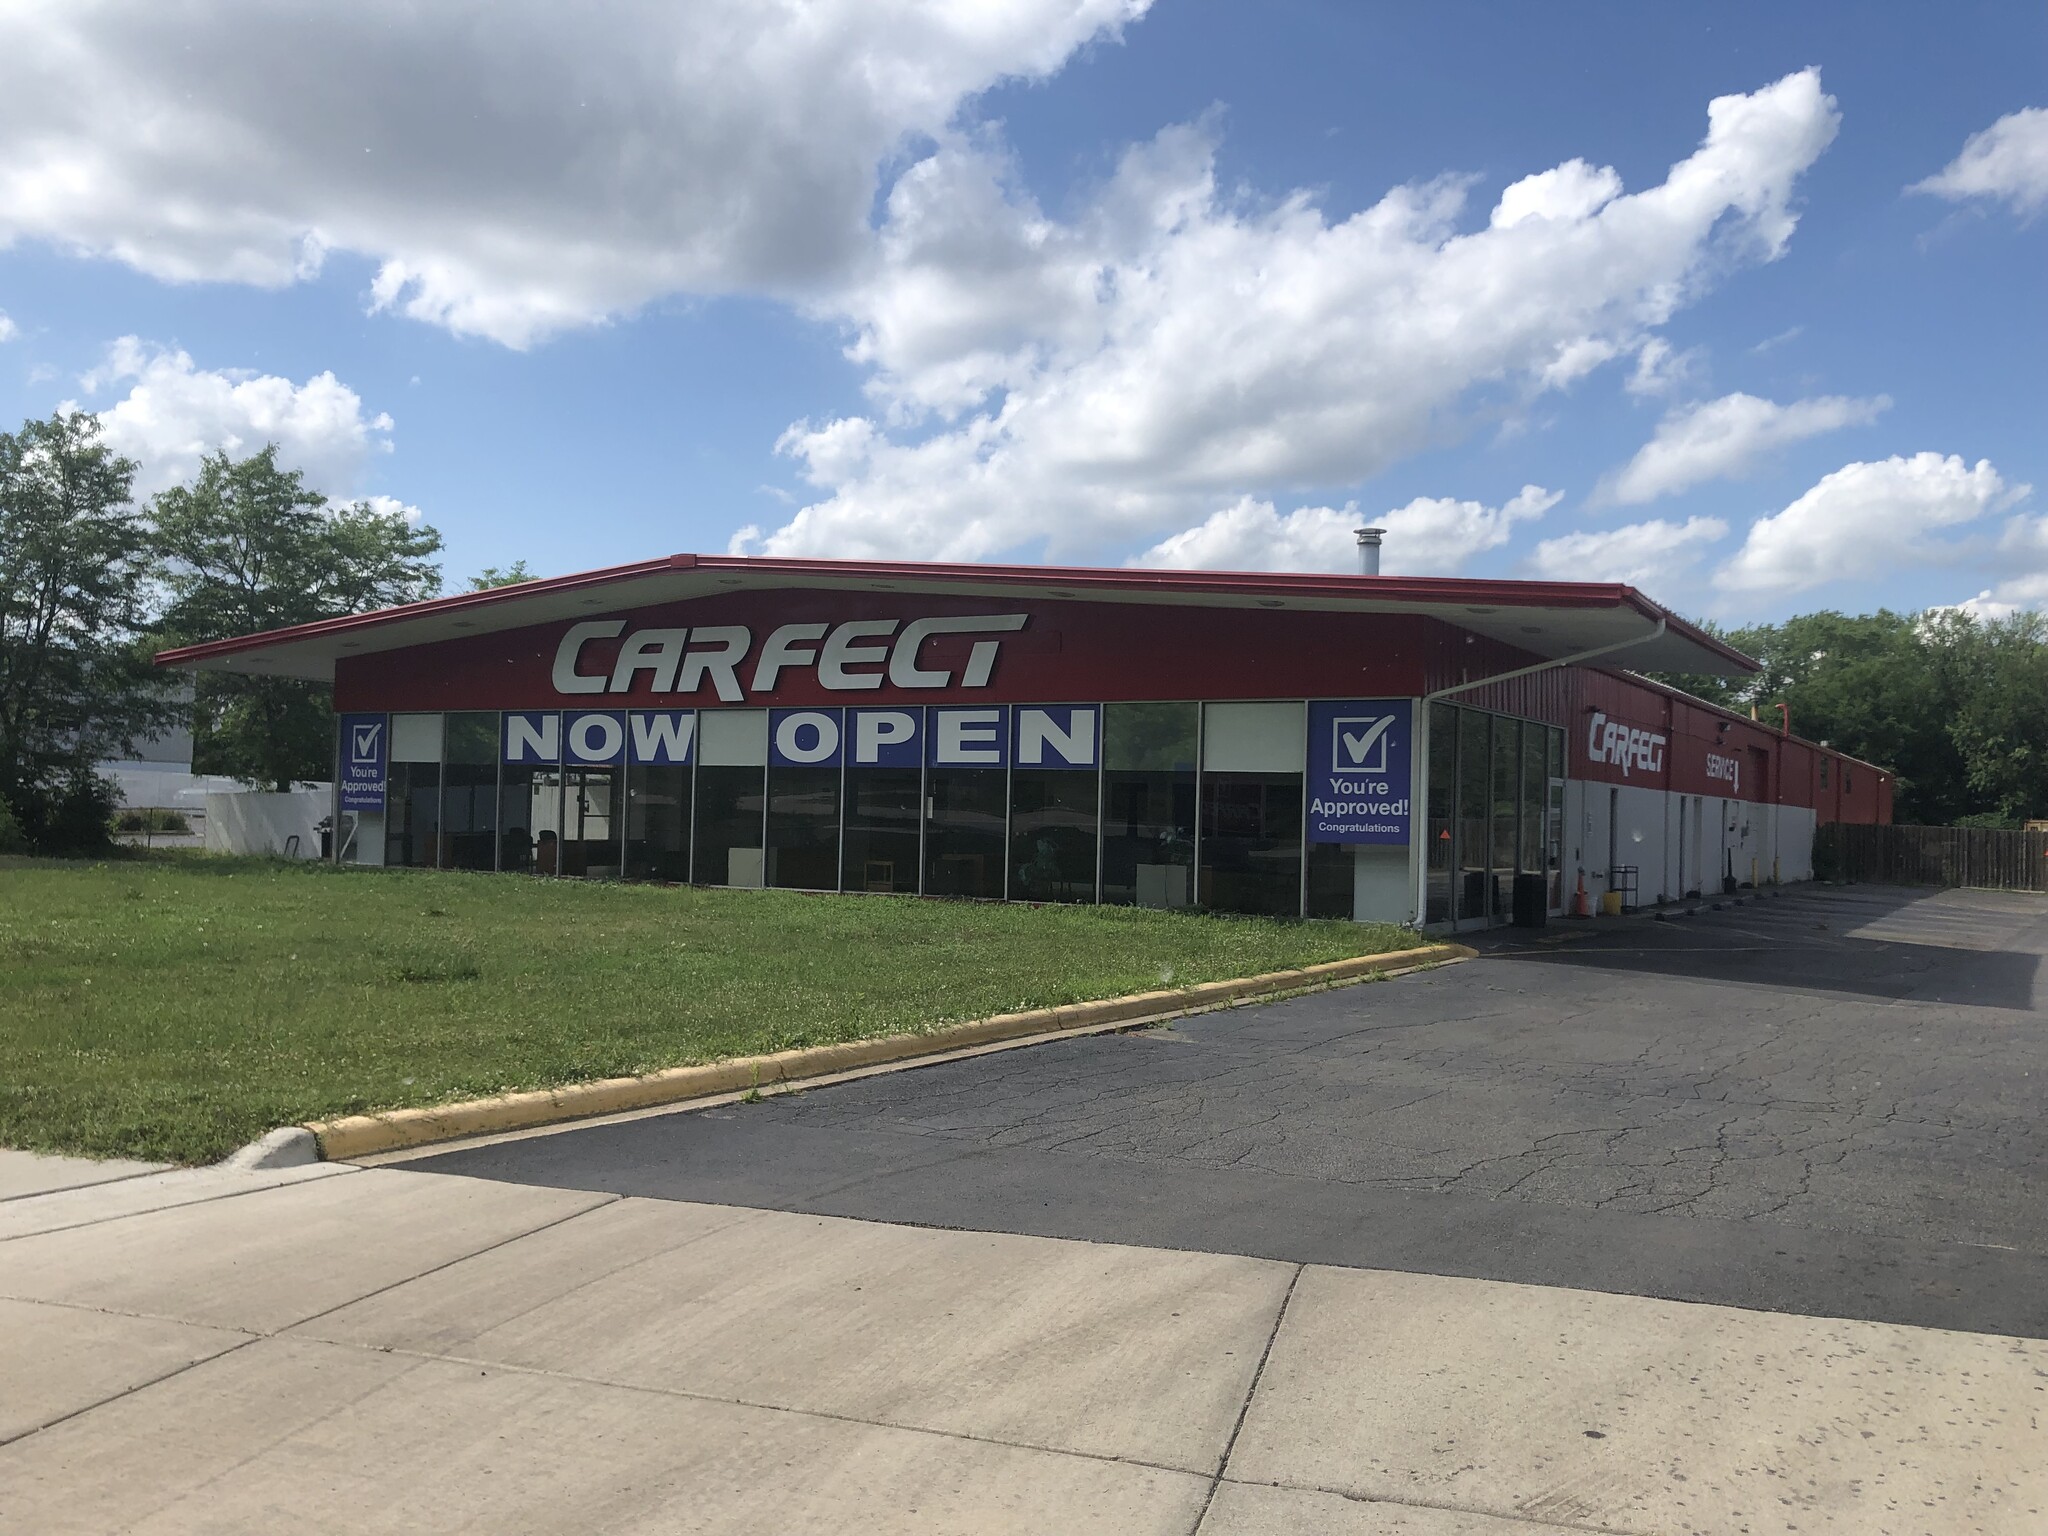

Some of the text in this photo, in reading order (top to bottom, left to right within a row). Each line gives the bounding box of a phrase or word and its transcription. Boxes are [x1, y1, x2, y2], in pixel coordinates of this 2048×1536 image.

[551, 613, 1029, 702] CARFECT
[507, 708, 1095, 765] NOW OPEN
[1589, 712, 1666, 777] CARFECT
[1706, 753, 1734, 781] SERVICE
[1329, 778, 1389, 795] You're
[1310, 798, 1409, 818] Approved!
[1318, 822, 1400, 833] Congratulations
